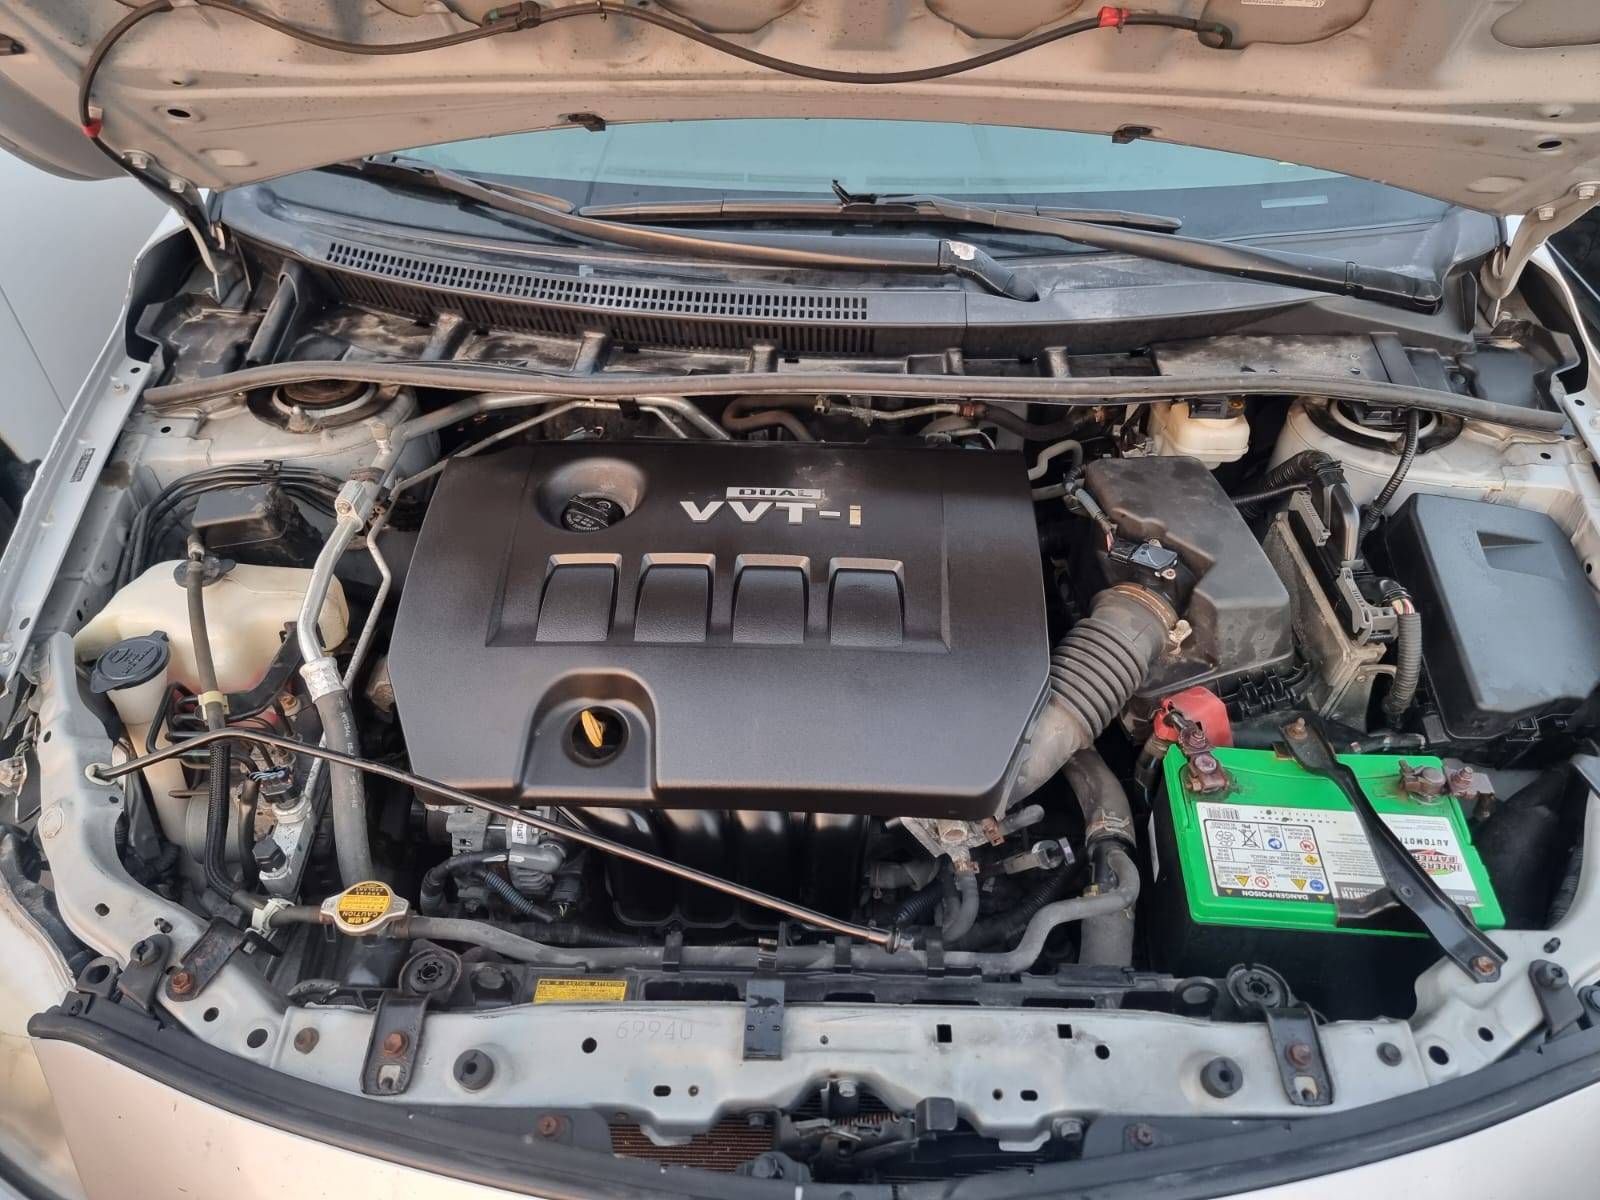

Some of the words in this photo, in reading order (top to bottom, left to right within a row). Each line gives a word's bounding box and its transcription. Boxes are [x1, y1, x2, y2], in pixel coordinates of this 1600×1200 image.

[737, 487, 815, 498] DUAL
[679, 501, 862, 527] VVT-i
[1242, 890, 1309, 901] DANGER/POISON
